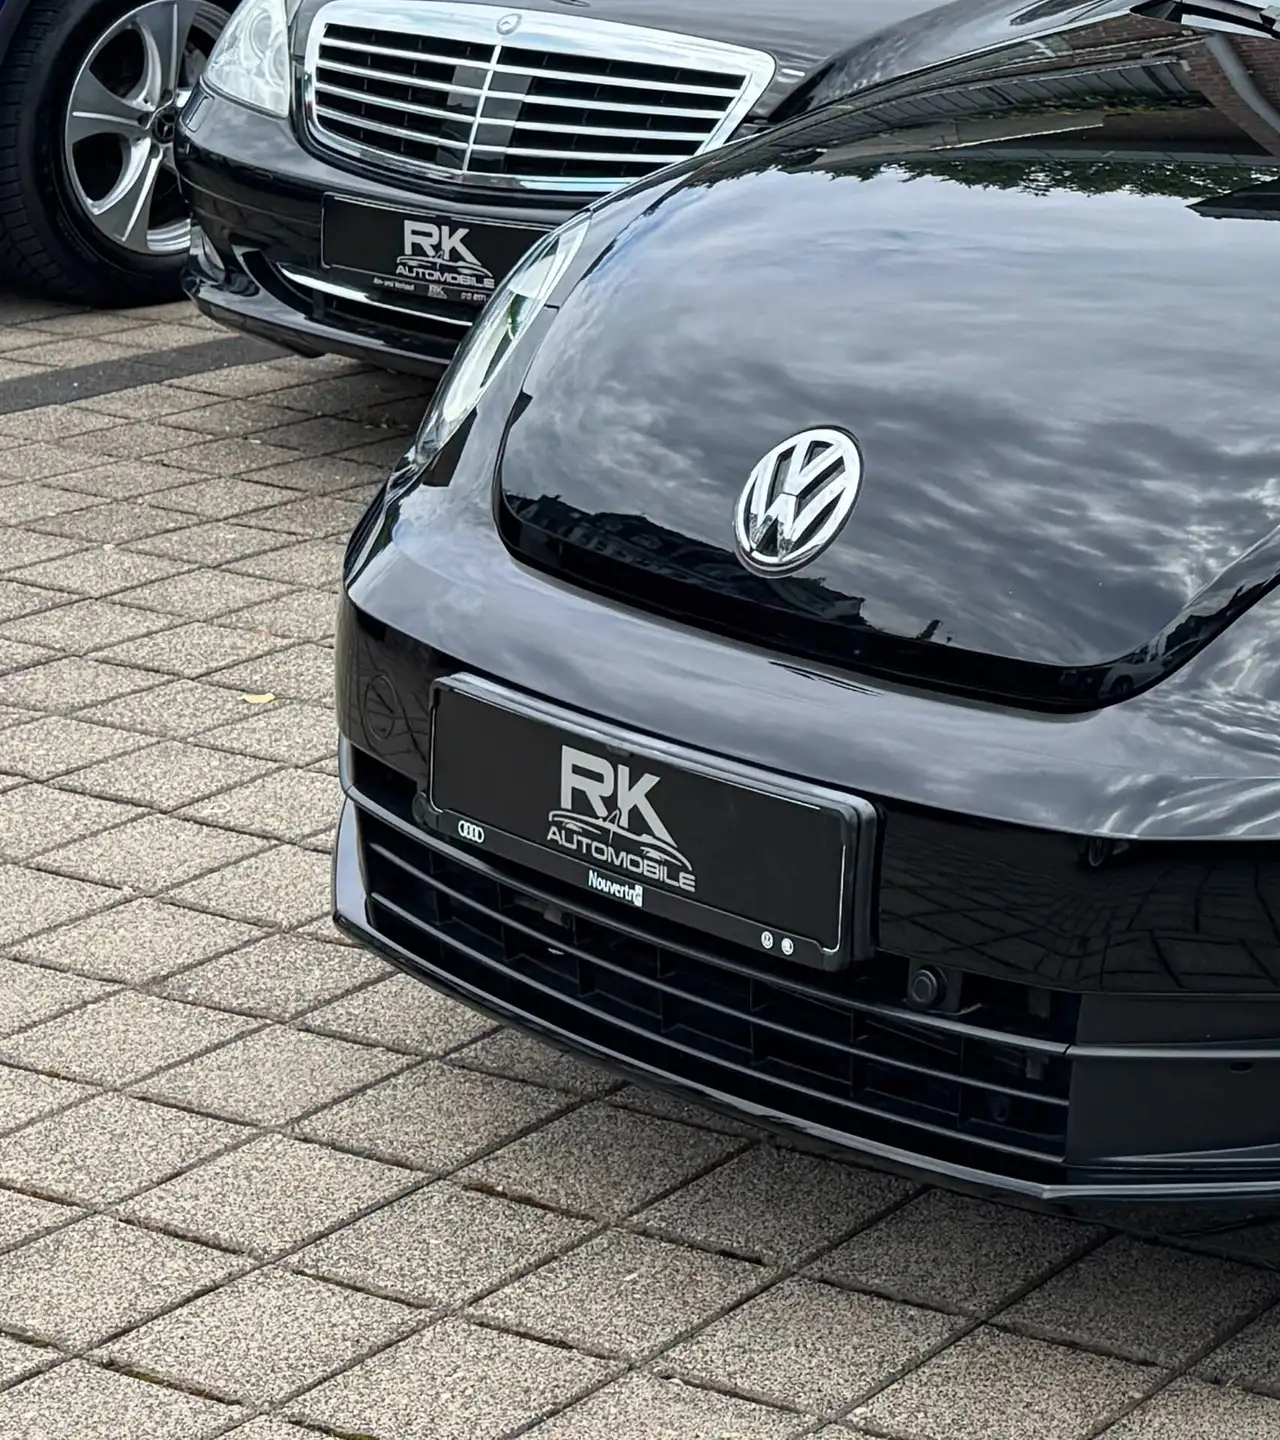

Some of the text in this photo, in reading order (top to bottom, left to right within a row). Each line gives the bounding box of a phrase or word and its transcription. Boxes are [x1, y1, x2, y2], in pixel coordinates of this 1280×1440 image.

[403, 219, 482, 267] RK
[396, 263, 496, 290] AUTOMOBILE
[561, 745, 678, 849] RK
[546, 825, 697, 893] AUTOMOBILE
